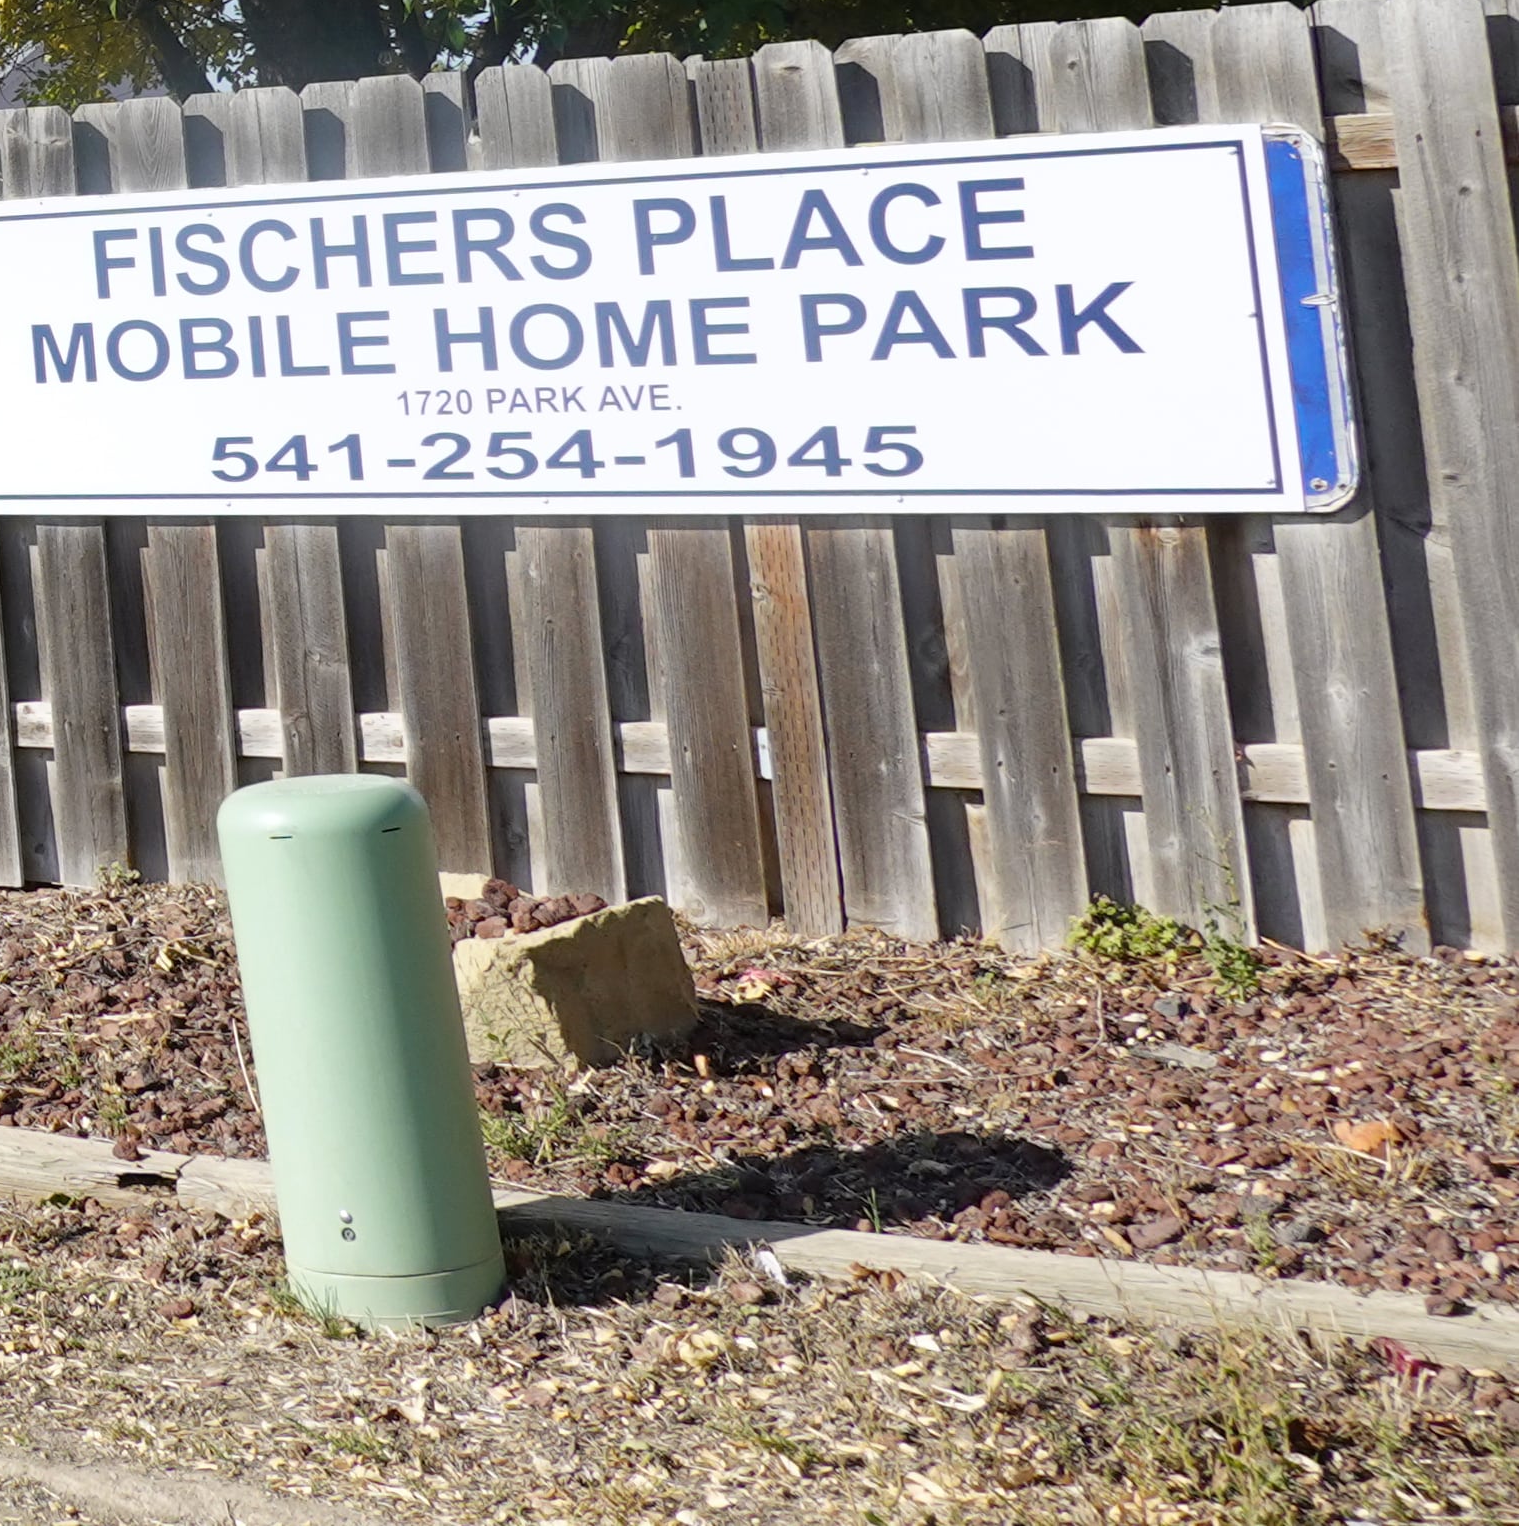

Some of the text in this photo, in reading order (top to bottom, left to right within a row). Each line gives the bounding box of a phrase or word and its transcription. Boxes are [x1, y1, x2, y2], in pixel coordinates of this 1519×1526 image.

[92, 176, 1035, 299] FISCHERS PLACE
[31, 281, 1145, 384] MOBILE HOME PARK
[397, 384, 682, 417] 1720 PARK AVE.
[211, 425, 924, 482] 541-254-1945
